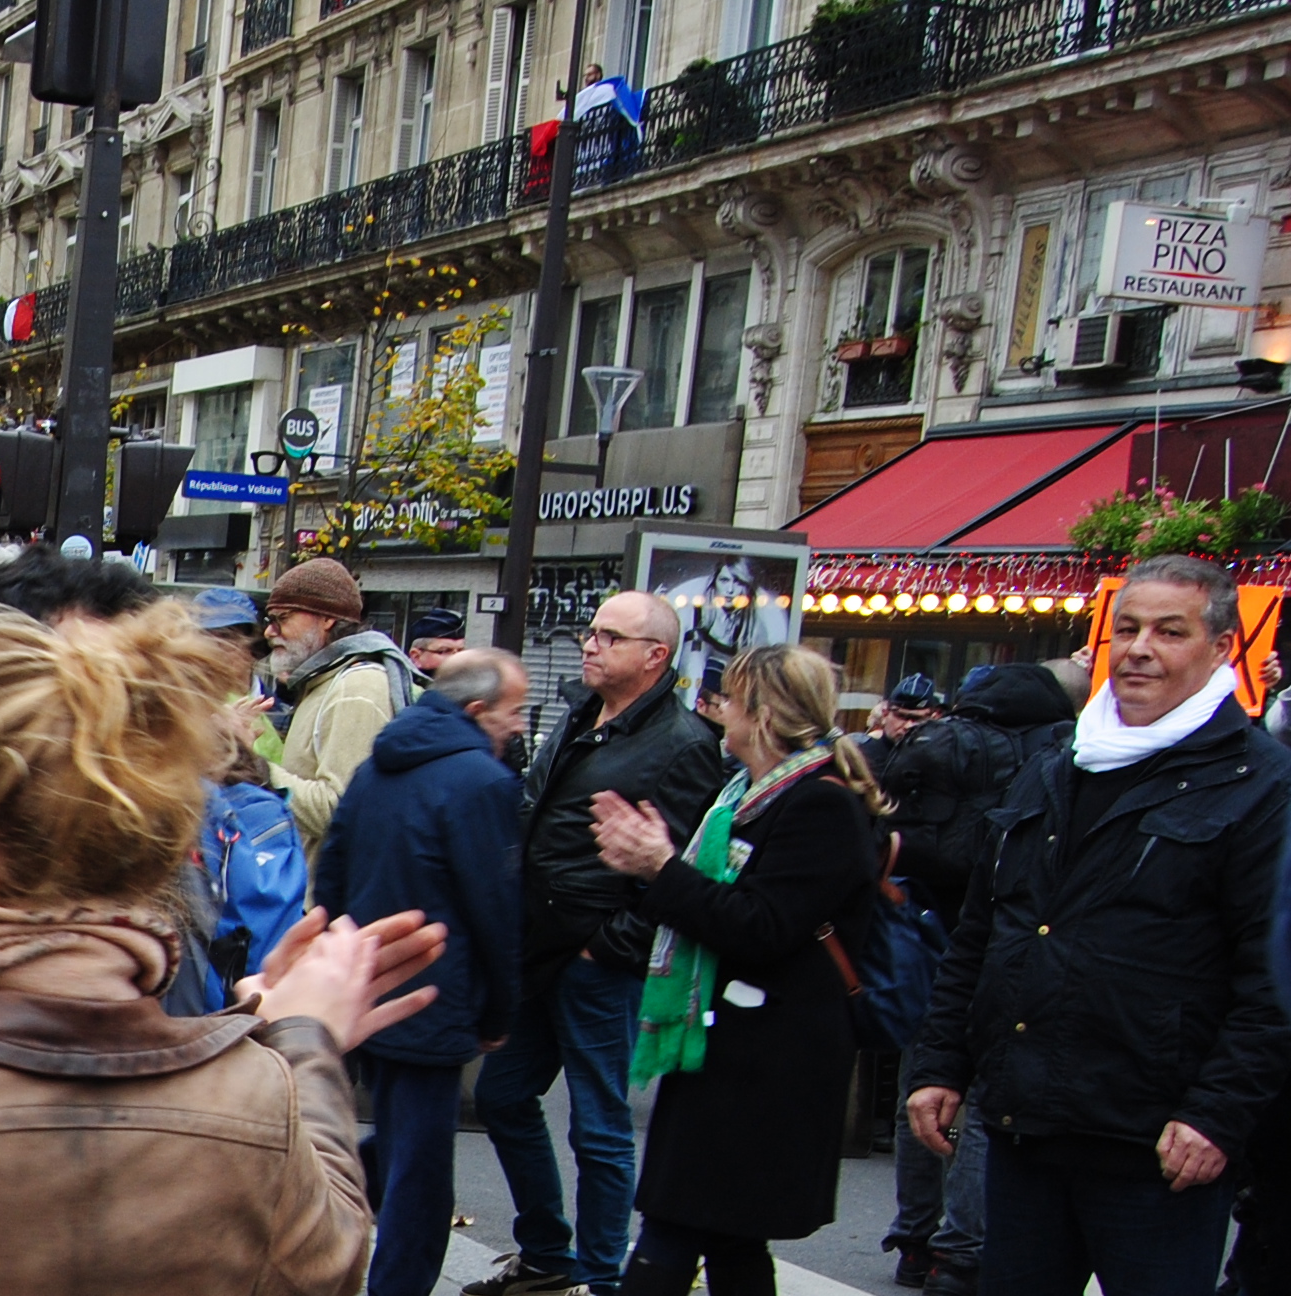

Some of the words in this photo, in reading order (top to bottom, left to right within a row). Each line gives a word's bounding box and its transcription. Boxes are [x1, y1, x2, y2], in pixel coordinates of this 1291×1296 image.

[1156, 218, 1227, 247] PIZZA
[1152, 243, 1226, 274] PINO
[1013, 240, 1046, 349] TAILLEURS
[1124, 275, 1247, 302] RESTAURANT
[285, 418, 315, 437] BUS
[189, 479, 239, 493] République
[247, 484, 283, 496] Voltaire
[538, 485, 692, 520] UROPSURPL.U.S
[489, 600, 496, 608] 2
